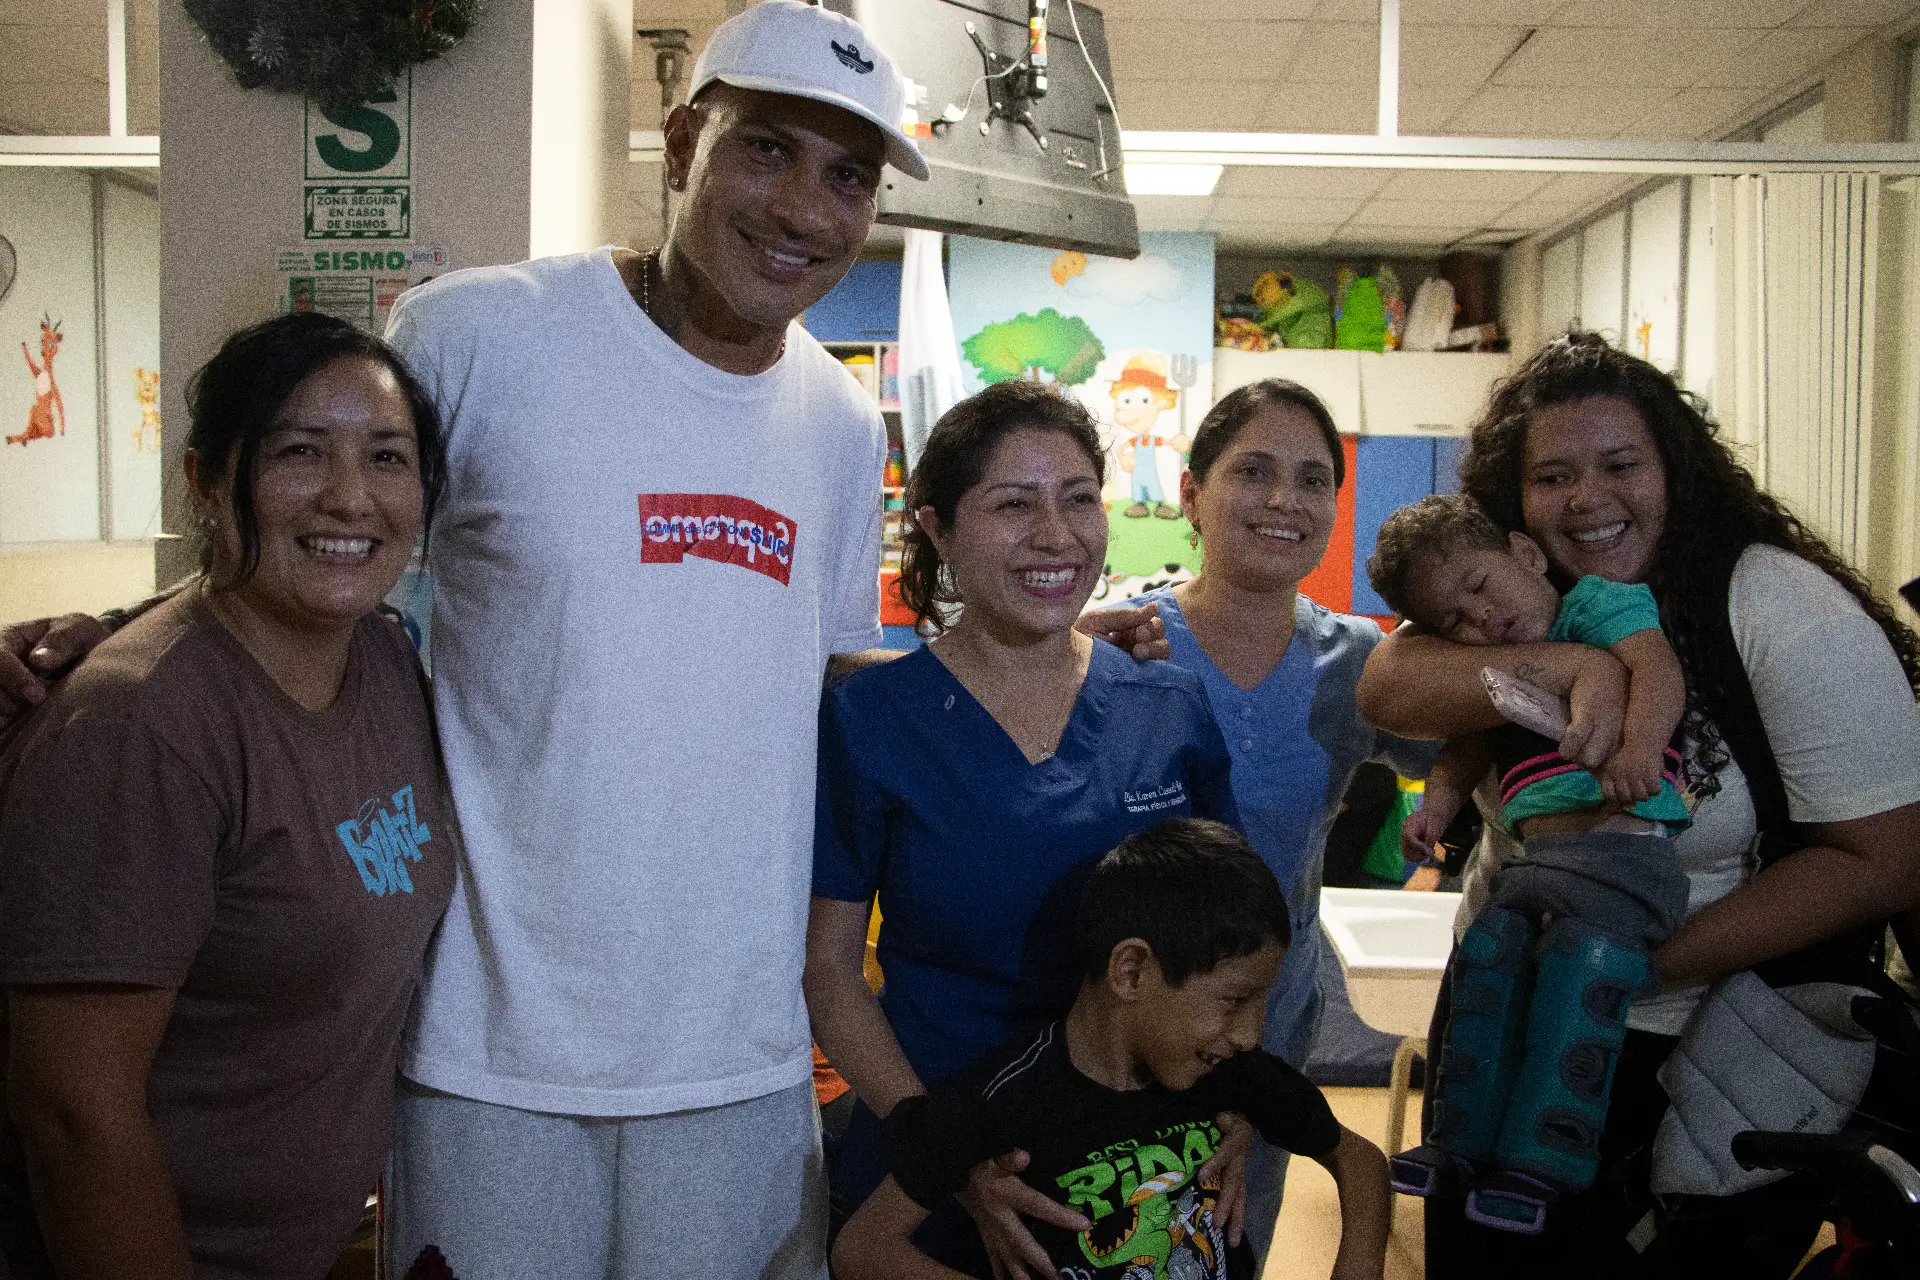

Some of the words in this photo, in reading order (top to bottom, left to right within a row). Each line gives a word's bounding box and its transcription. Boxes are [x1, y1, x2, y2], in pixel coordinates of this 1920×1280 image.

[315, 87, 401, 172] S
[317, 196, 348, 205] ZONA
[352, 196, 398, 205] SEGURA
[329, 208, 344, 217] EN
[347, 208, 385, 217] CASOS
[327, 220, 341, 229] DE
[345, 220, 387, 229] SISMOS
[313, 251, 405, 270] SISMO
